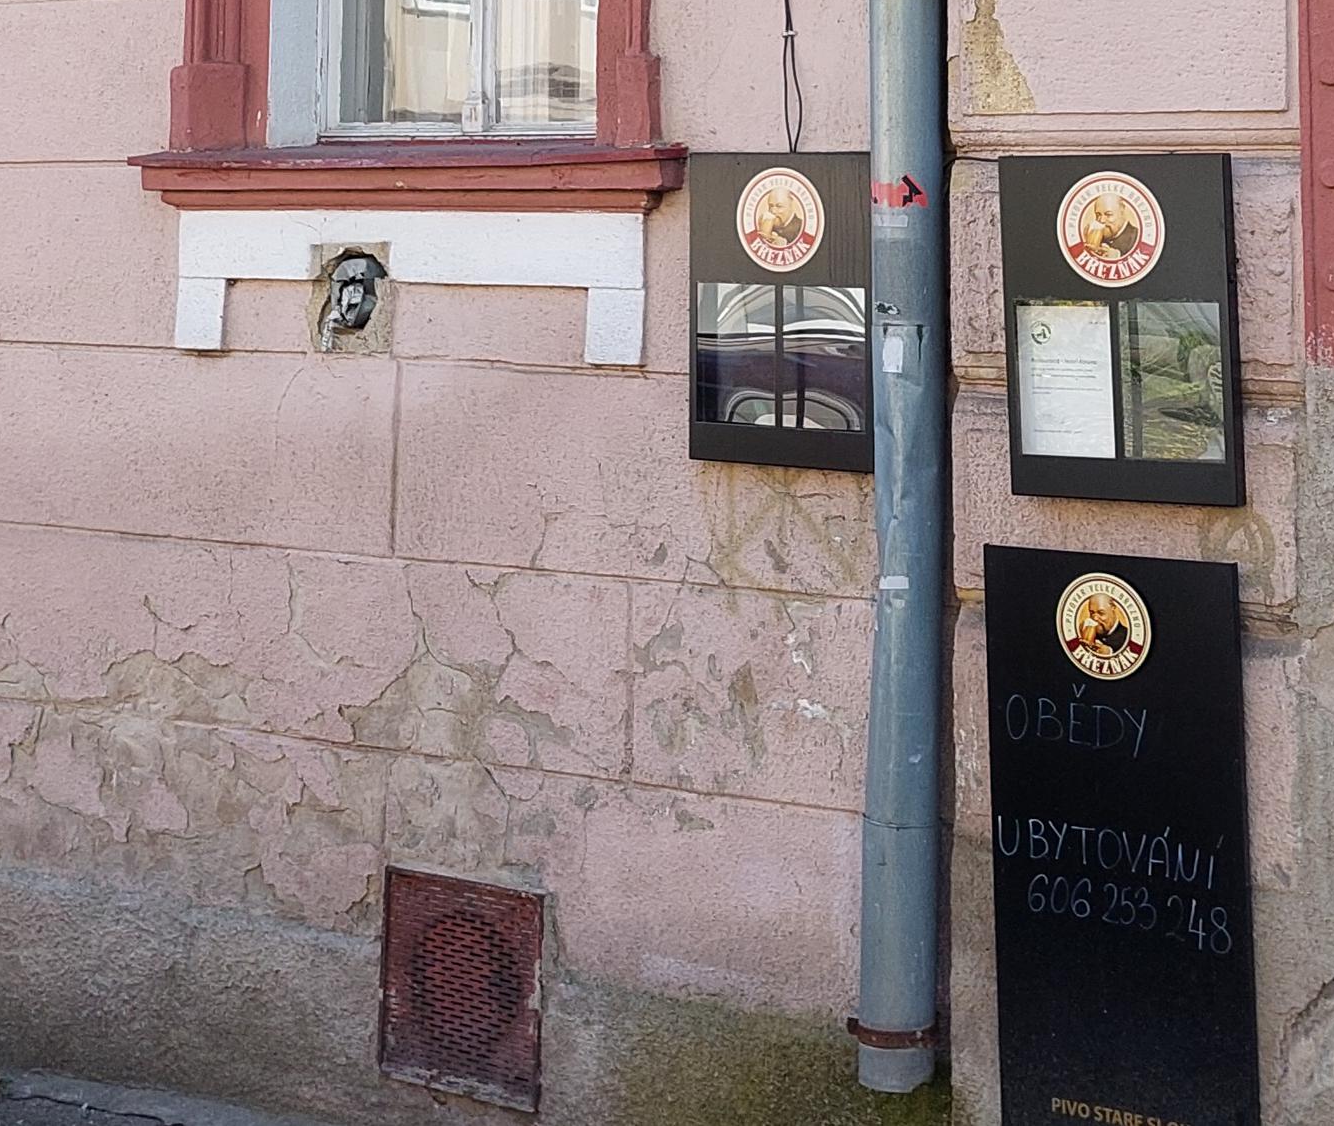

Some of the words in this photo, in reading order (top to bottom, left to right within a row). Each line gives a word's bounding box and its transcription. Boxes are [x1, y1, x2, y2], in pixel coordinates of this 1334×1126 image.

[1076, 249, 1150, 279] BŘEZŇÁK
[1072, 645, 1139, 674] BŘEZŇÁK
[1006, 683, 1147, 758] OBĚDY
[997, 815, 1223, 889] UBYTOVÁNÍ
[1027, 874, 1091, 918] 606
[1102, 883, 1157, 930] 253
[1166, 895, 1233, 954] 248
[1051, 1097, 1090, 1118] PIVO
